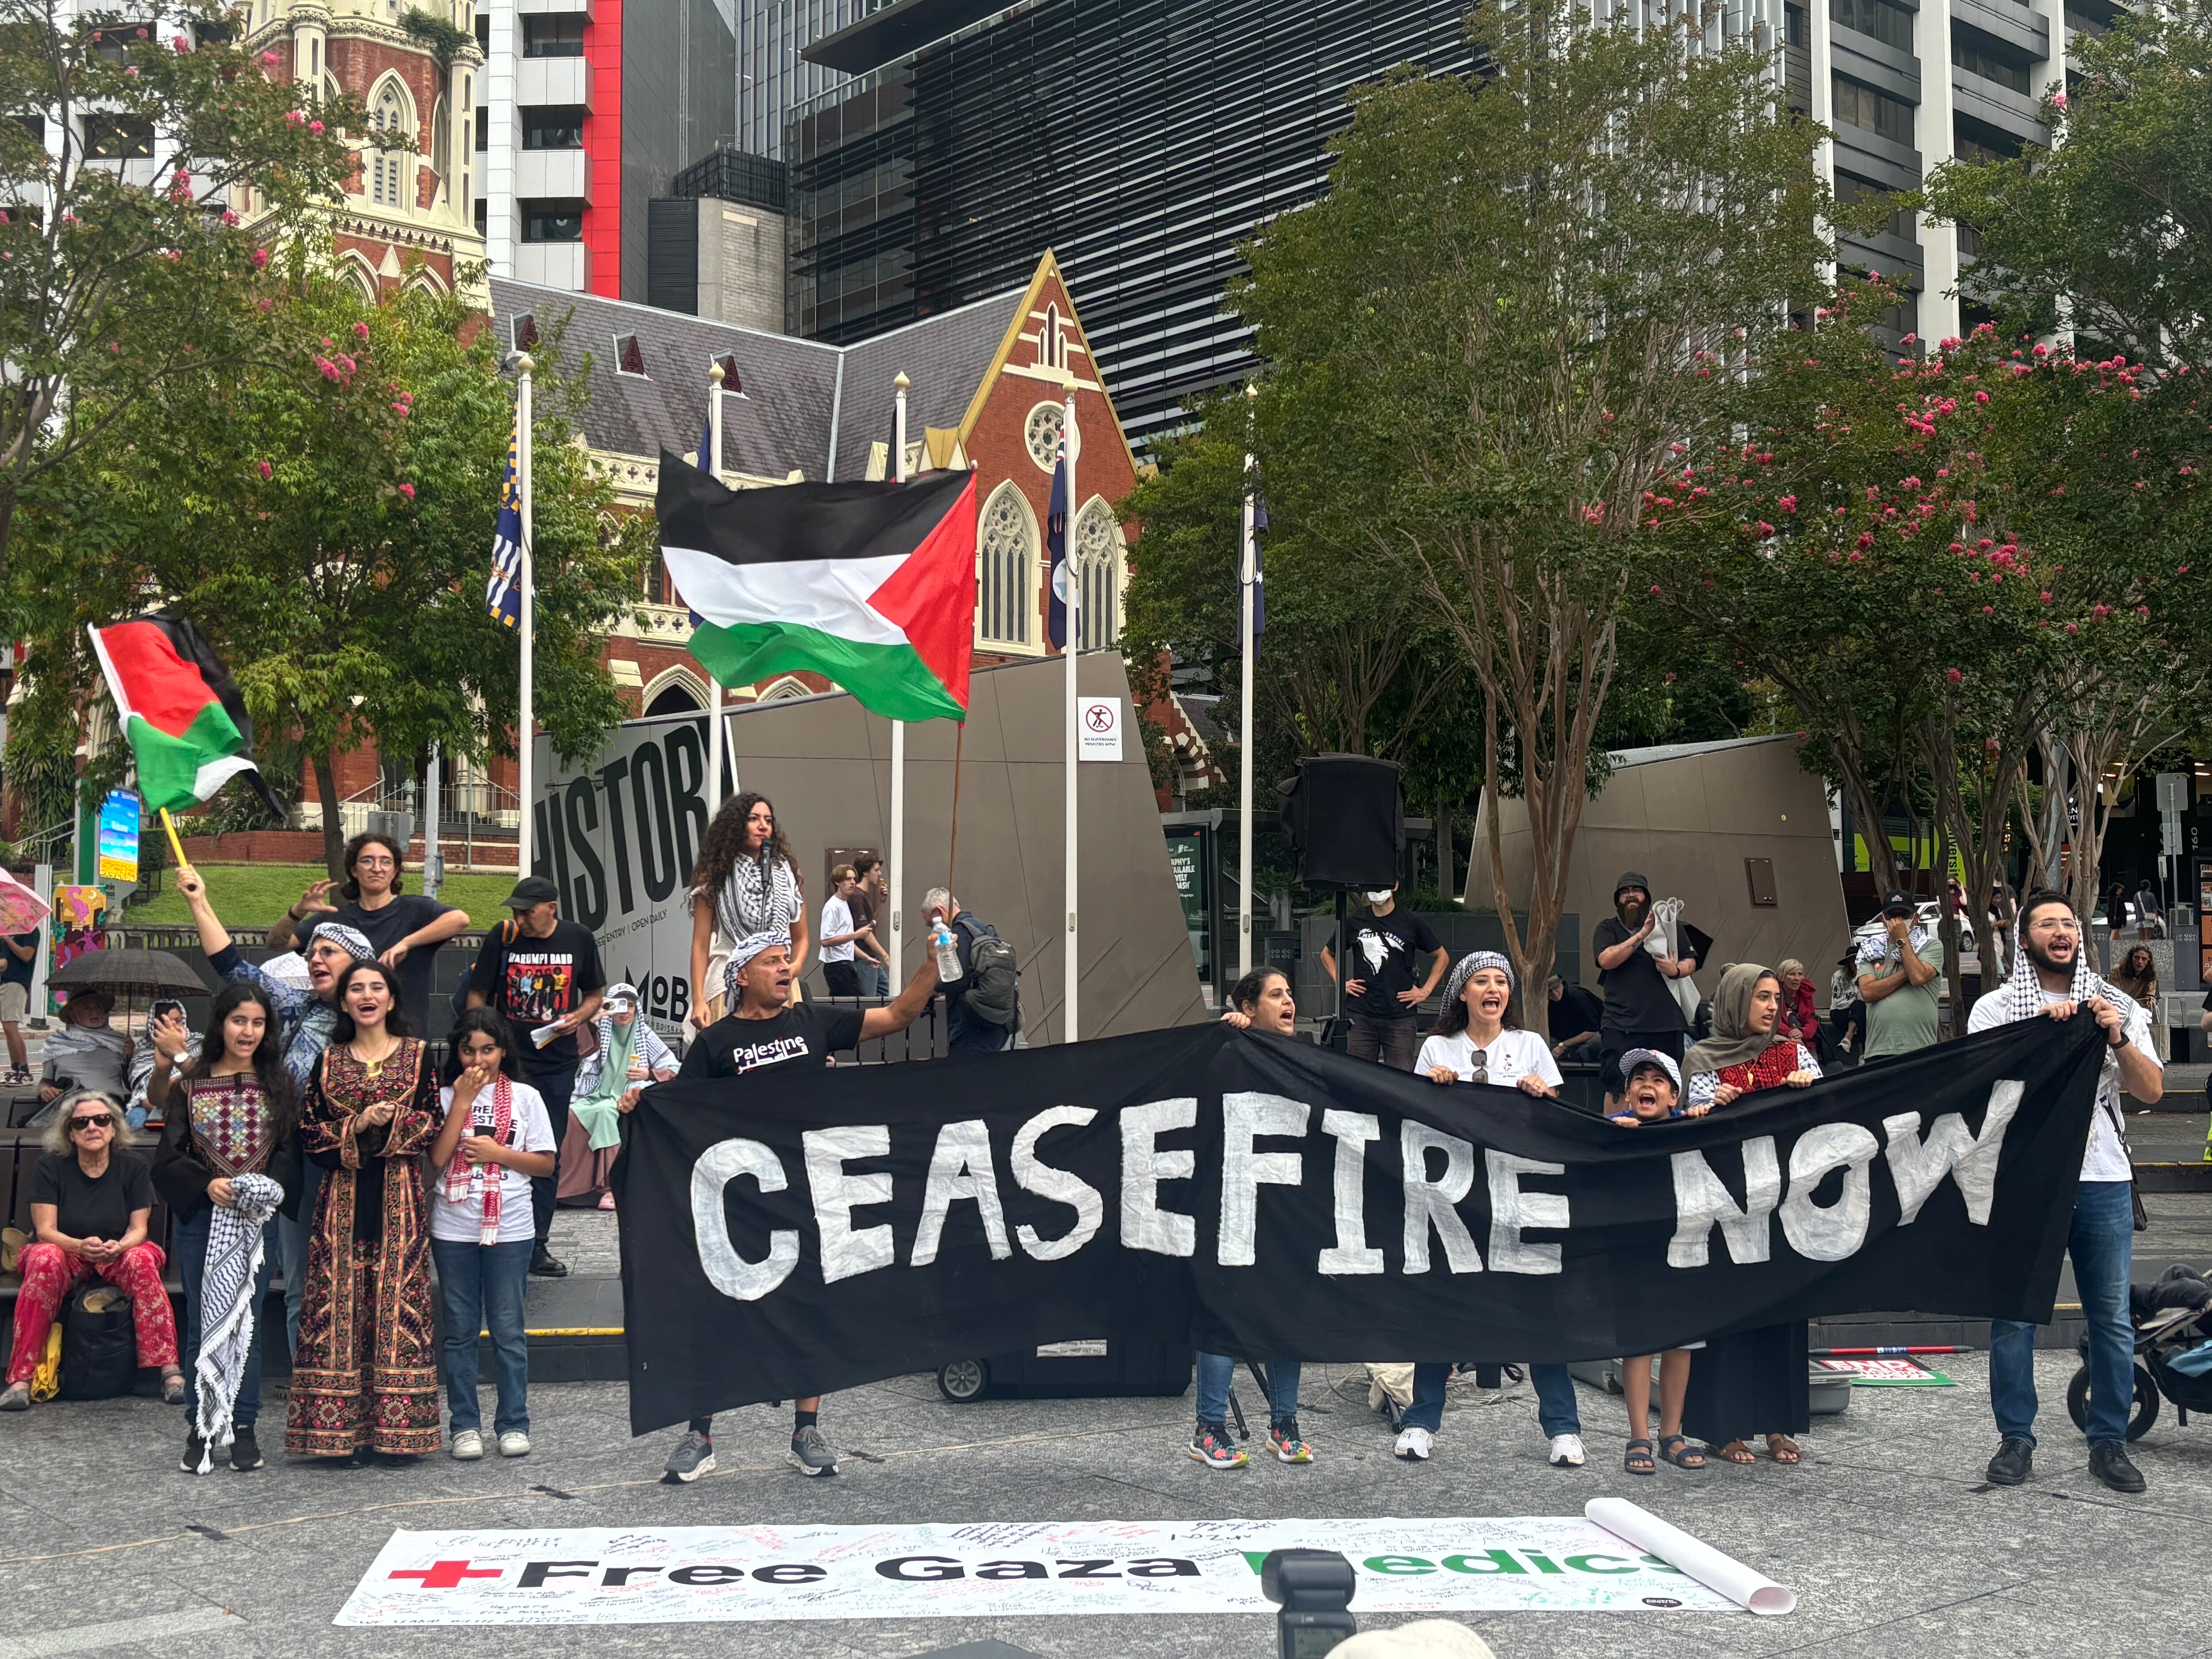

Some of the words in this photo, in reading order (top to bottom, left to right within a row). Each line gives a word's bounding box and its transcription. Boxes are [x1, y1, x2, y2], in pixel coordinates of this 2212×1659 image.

[1171, 857, 1190, 866] RPHY'S
[1173, 865, 1195, 874] AILABLE
[607, 926, 626, 942] ENTRY
[631, 917, 649, 931] OPEN
[550, 953, 573, 964] BAND
[733, 1036, 805, 1064] Palestine
[691, 1091, 1570, 1301] CEASEFIRE
[1667, 1080, 2026, 1268] NOW
[517, 1561, 827, 1588] Free
[875, 1556, 1202, 1581] Gaza
[1241, 1550, 1685, 1575] edic
